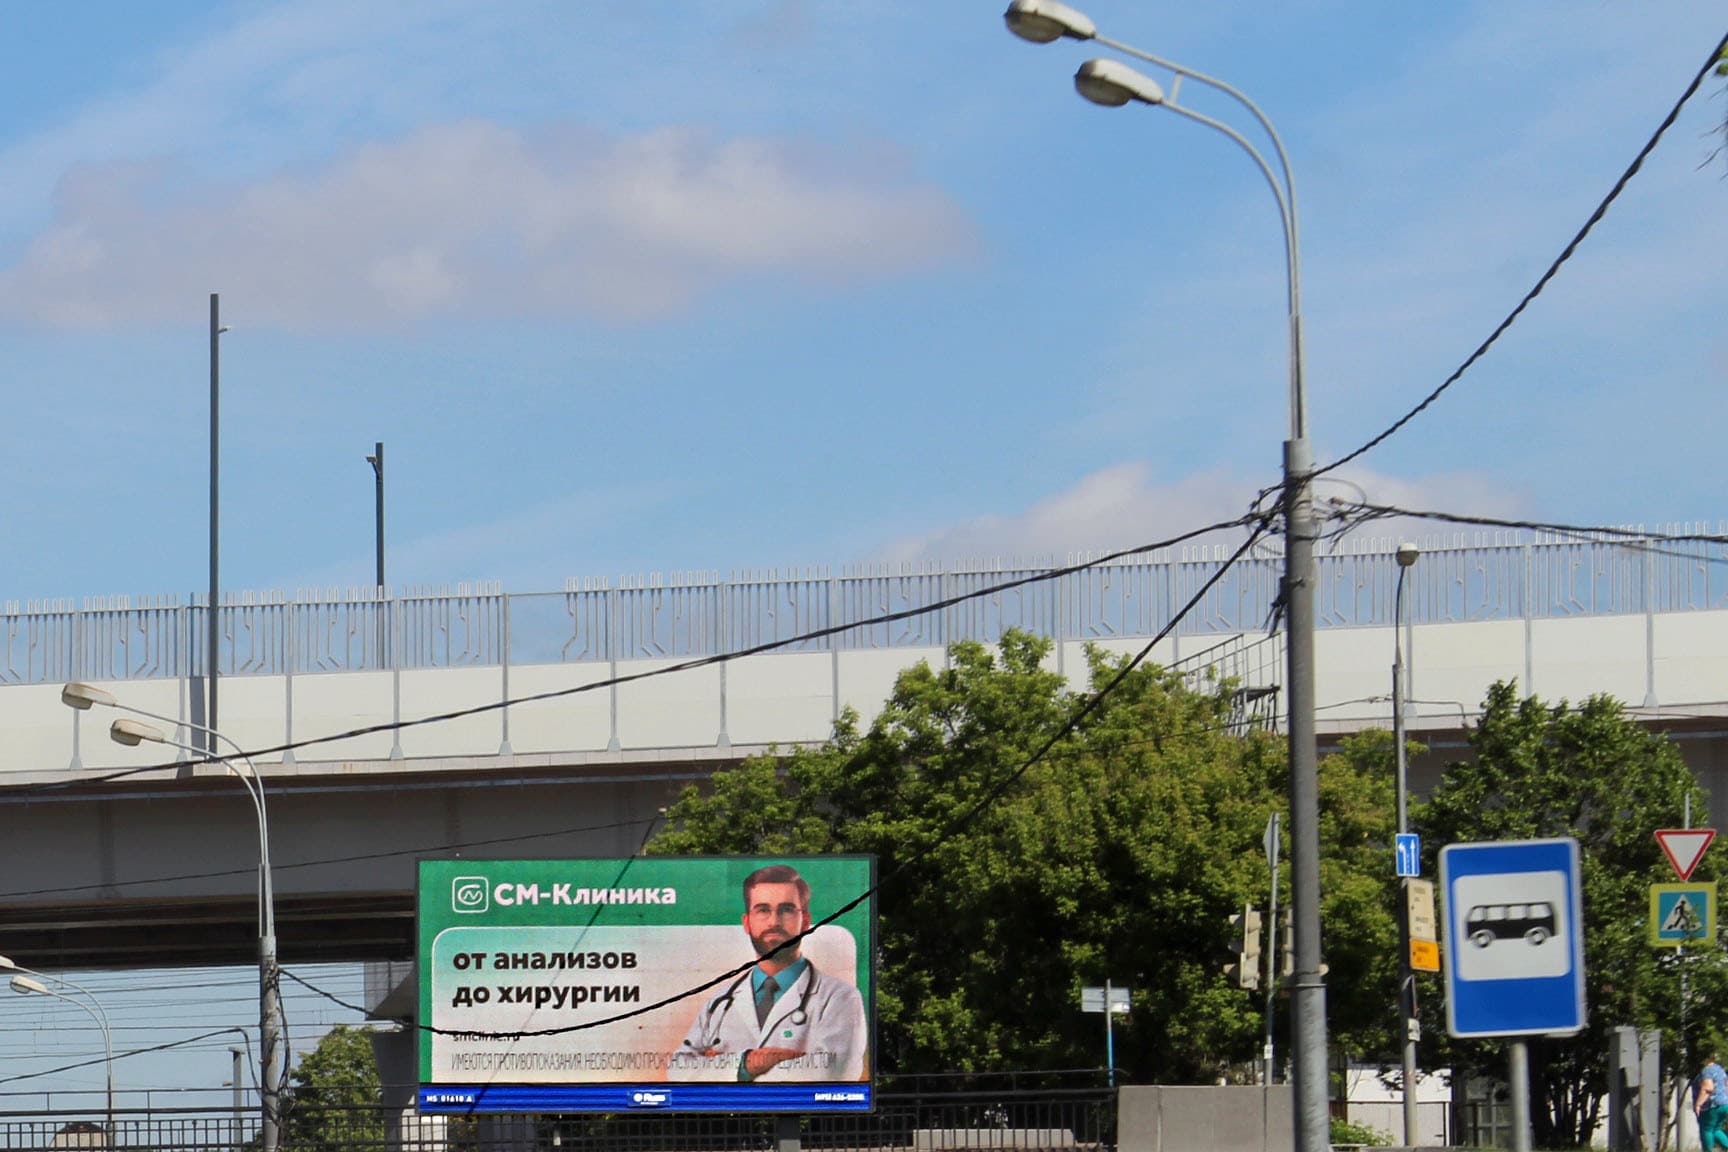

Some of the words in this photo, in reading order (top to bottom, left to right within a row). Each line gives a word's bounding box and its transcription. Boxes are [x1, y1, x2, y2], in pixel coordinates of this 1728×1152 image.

[494, 883, 676, 906] СМ-Клиника
[453, 952, 487, 970] от
[494, 951, 638, 970] анализов
[452, 985, 490, 1008] до
[497, 985, 640, 1009] хирургии
